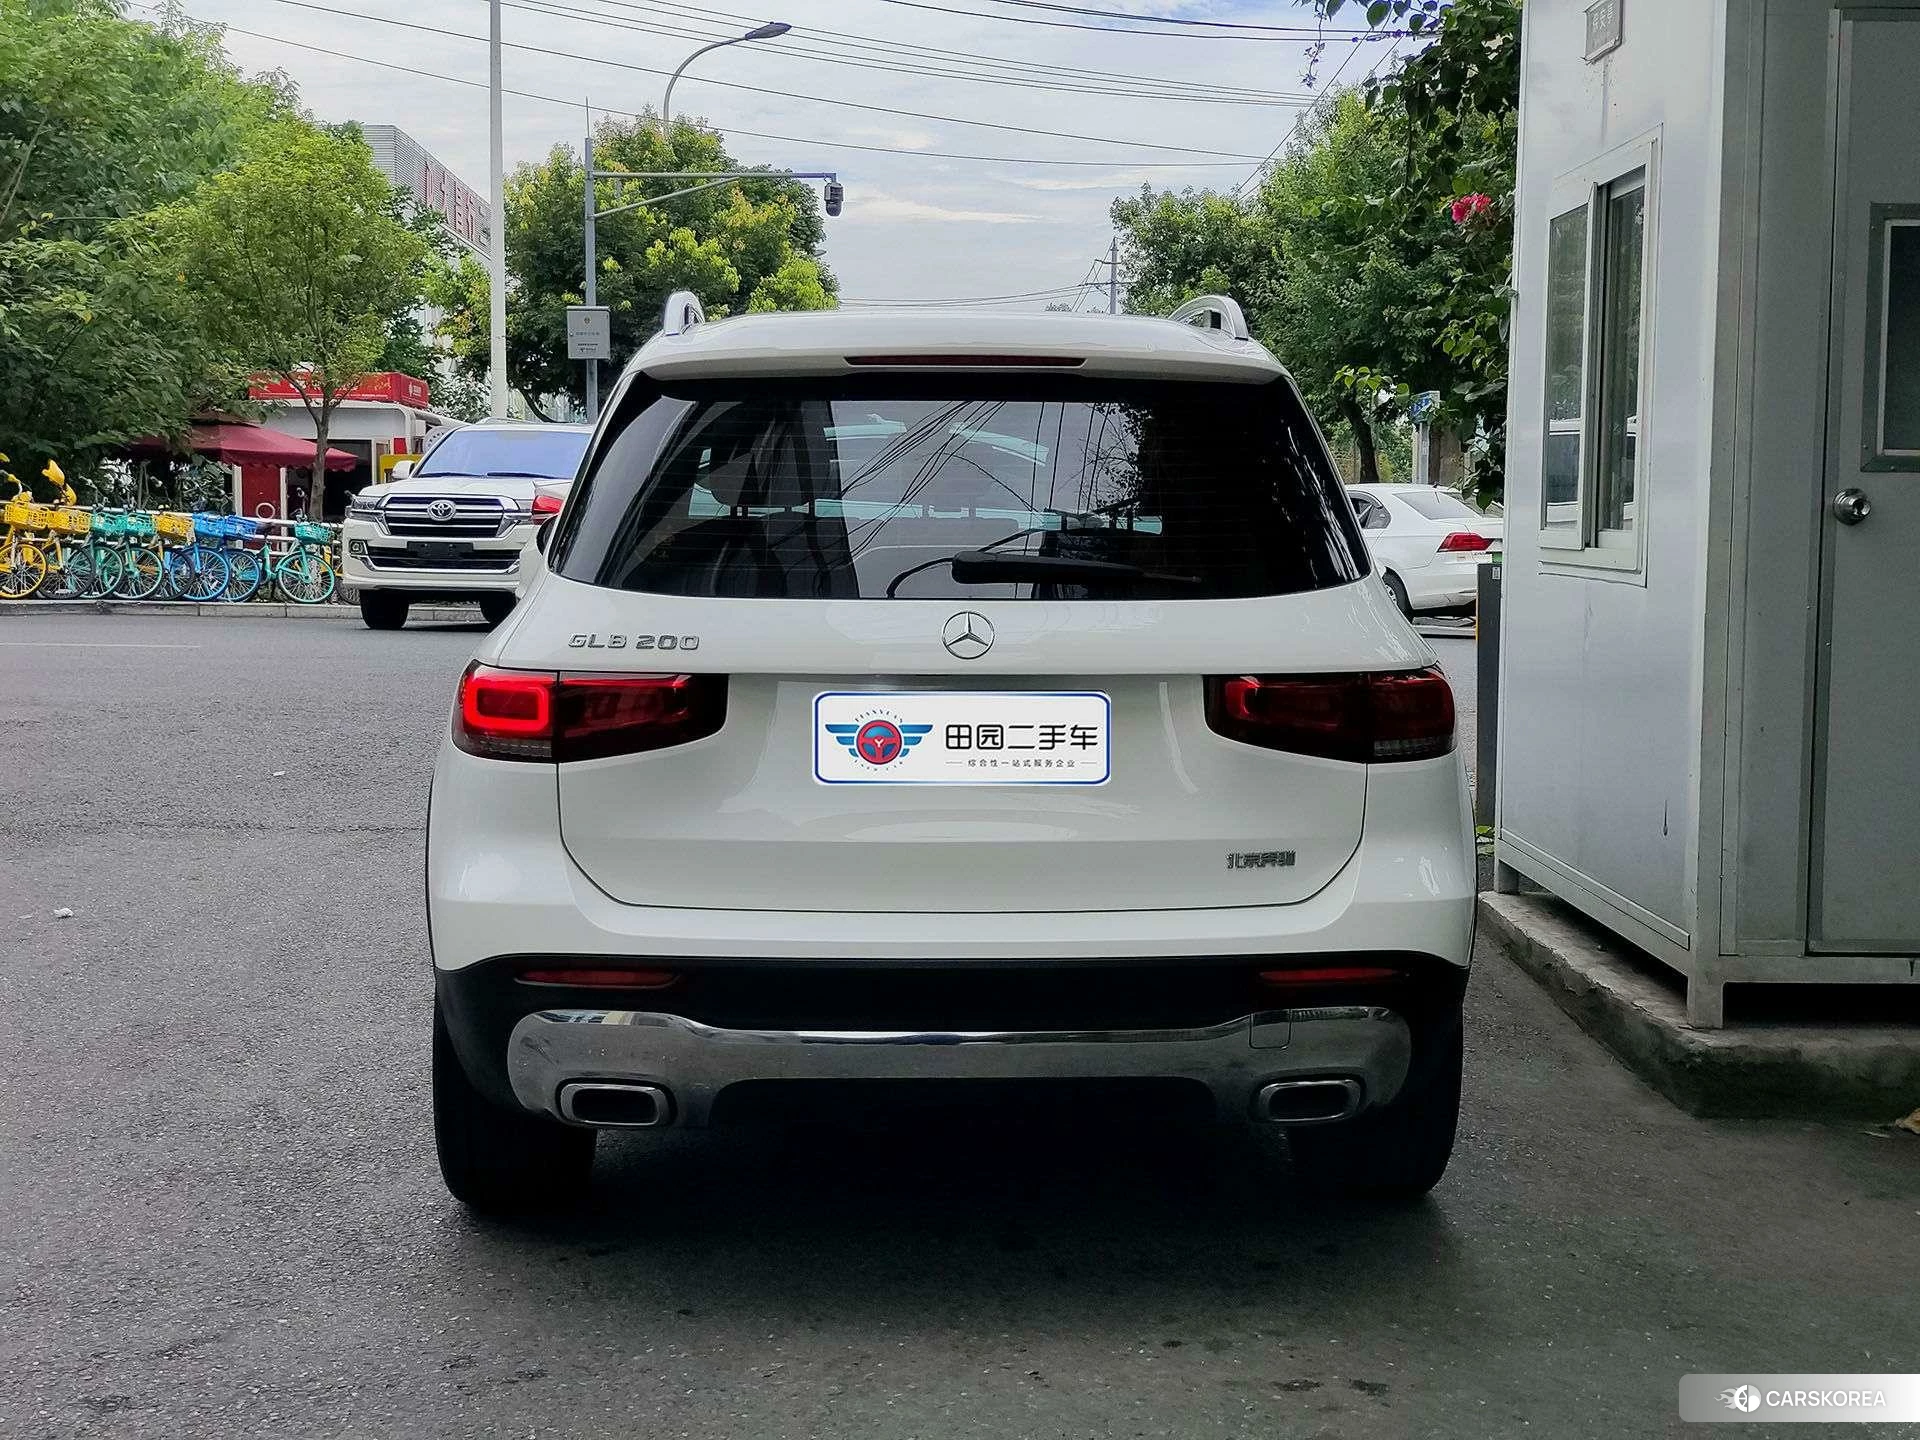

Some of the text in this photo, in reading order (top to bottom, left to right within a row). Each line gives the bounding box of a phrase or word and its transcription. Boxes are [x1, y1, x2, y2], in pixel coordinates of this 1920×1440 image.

[568, 634, 699, 650] GLB 200
[946, 724, 1098, 750] 田园二手车
